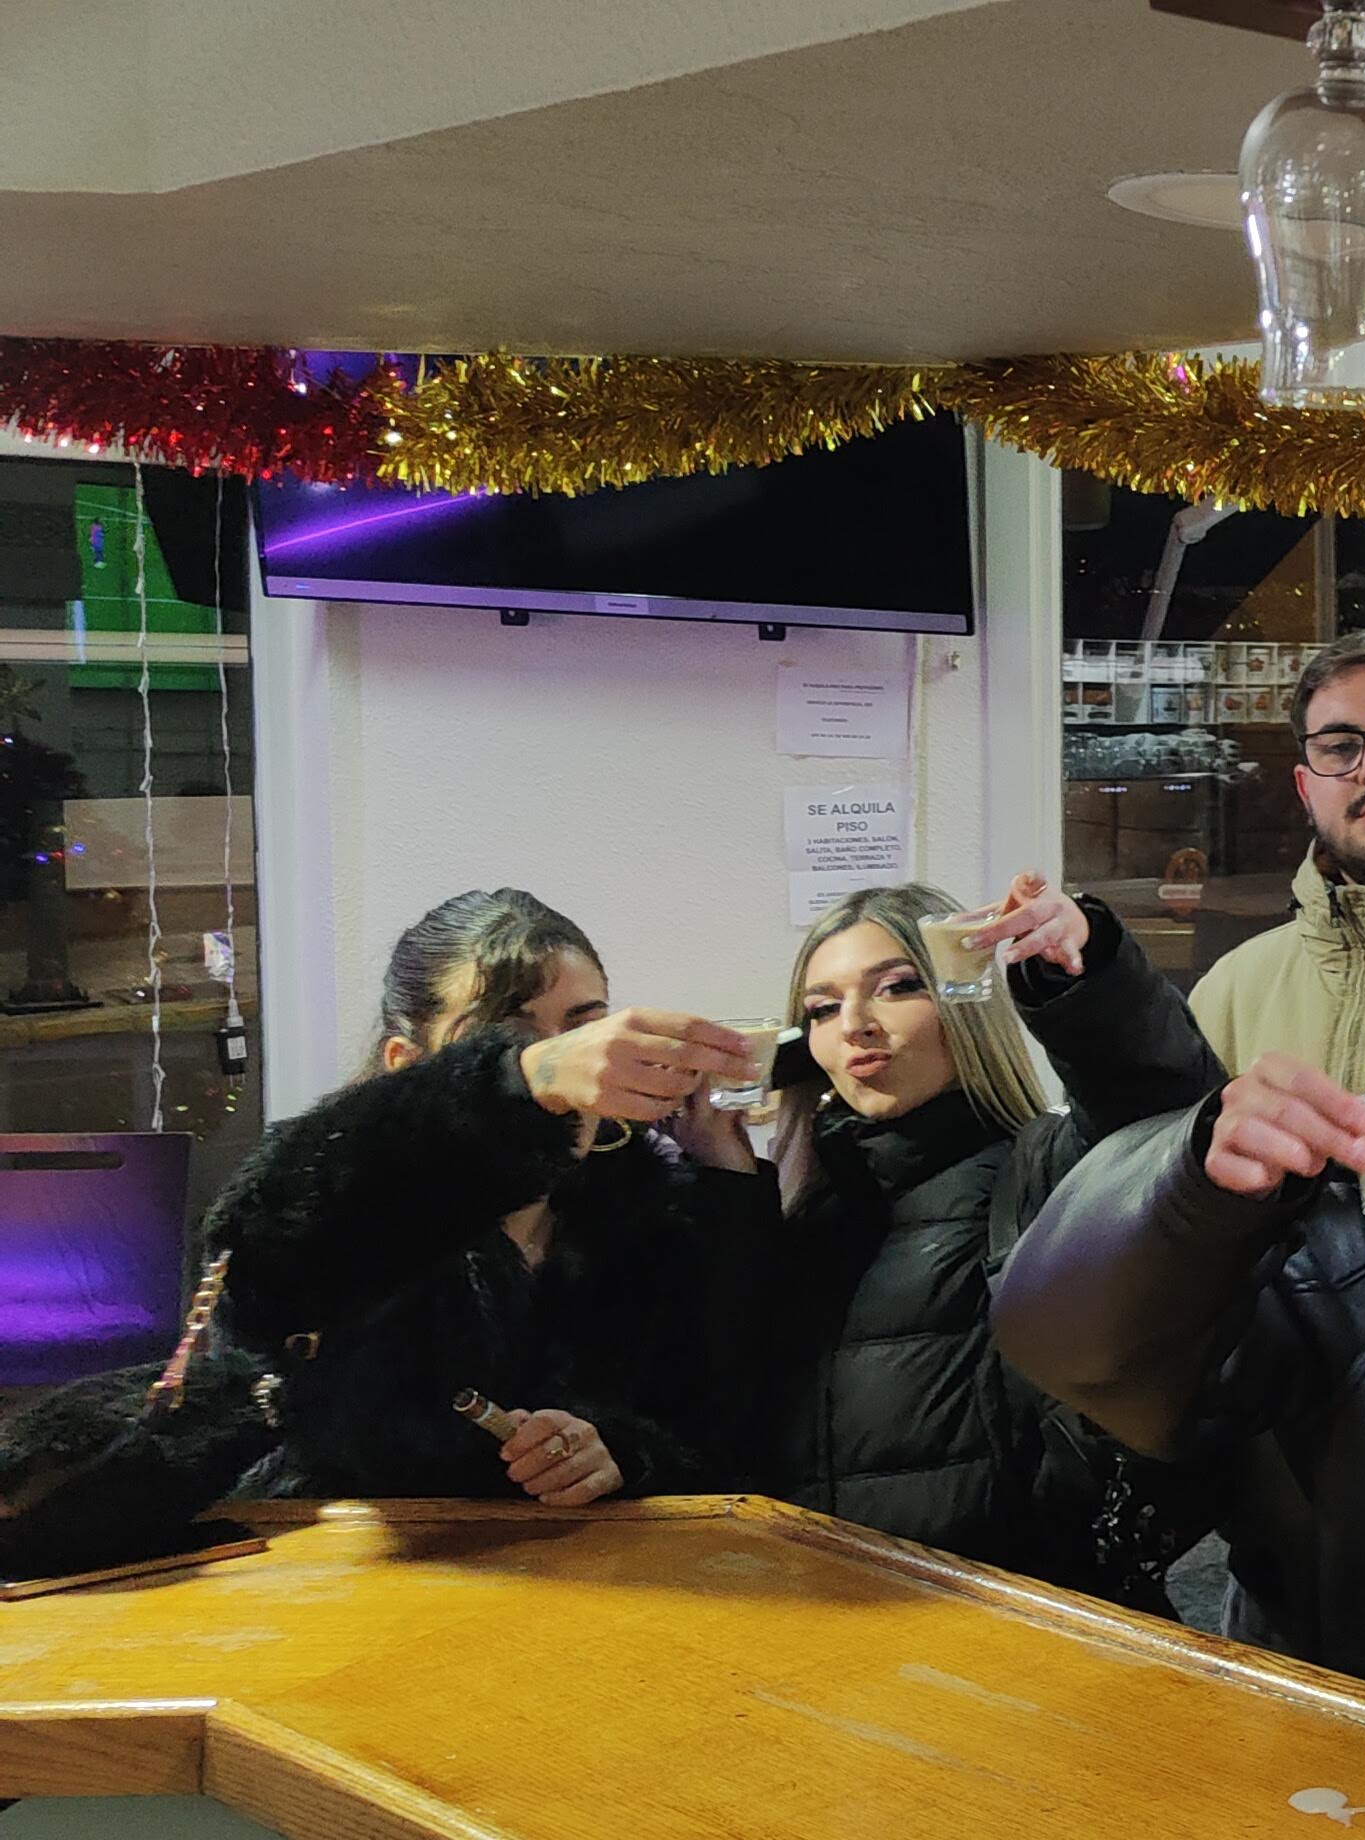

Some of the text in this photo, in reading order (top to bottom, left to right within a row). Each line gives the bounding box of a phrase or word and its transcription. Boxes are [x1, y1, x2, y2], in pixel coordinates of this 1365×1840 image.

[807, 802, 896, 816] SE ALQUILA
[837, 821, 868, 832] PISO
